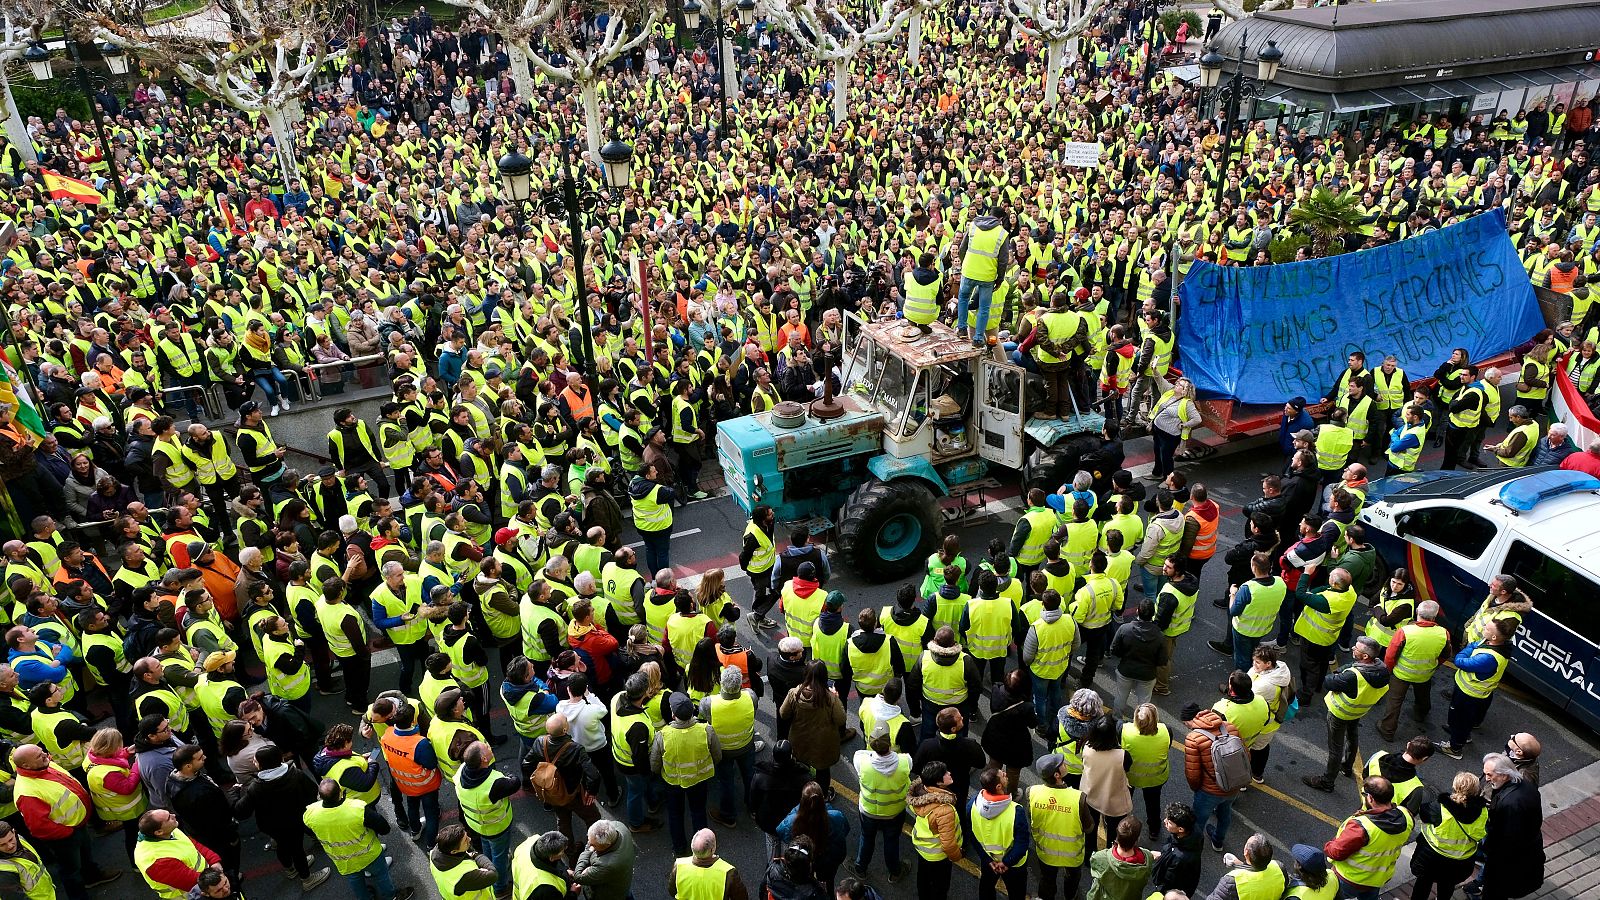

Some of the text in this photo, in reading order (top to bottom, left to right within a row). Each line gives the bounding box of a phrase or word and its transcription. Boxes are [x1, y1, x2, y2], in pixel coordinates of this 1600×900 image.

[1363, 251, 1504, 330] DECEPCIONES
[1511, 634, 1600, 701] CIONAL
[1516, 624, 1585, 675] OLICÍA
